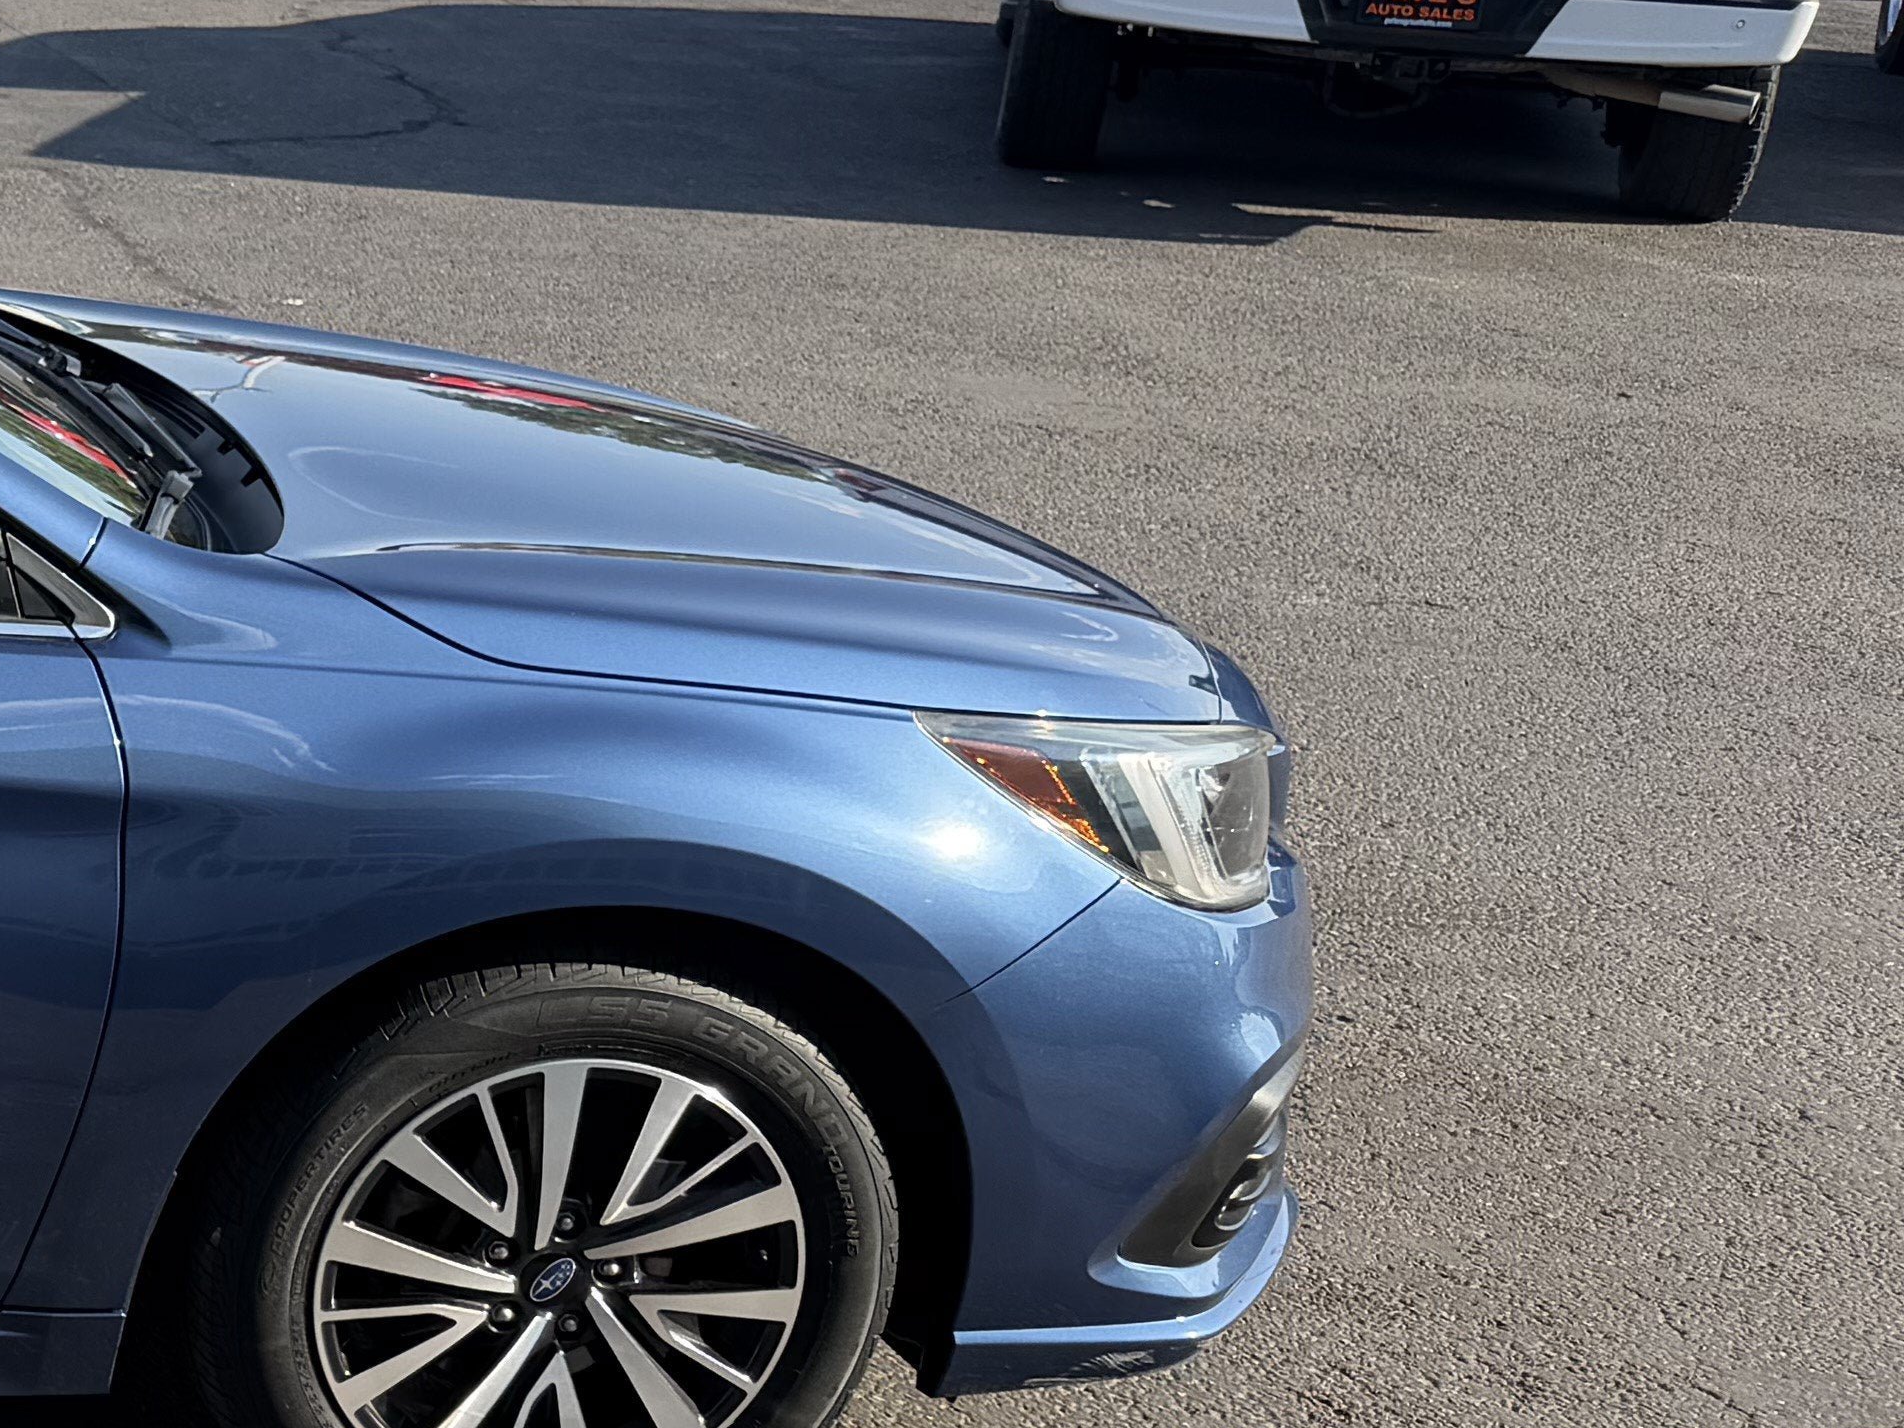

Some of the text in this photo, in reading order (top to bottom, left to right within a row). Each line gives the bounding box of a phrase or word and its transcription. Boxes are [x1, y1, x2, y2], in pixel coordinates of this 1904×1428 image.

[1365, 2, 1475, 21] AUTO SALES
[821, 1142, 859, 1258] TOURING
